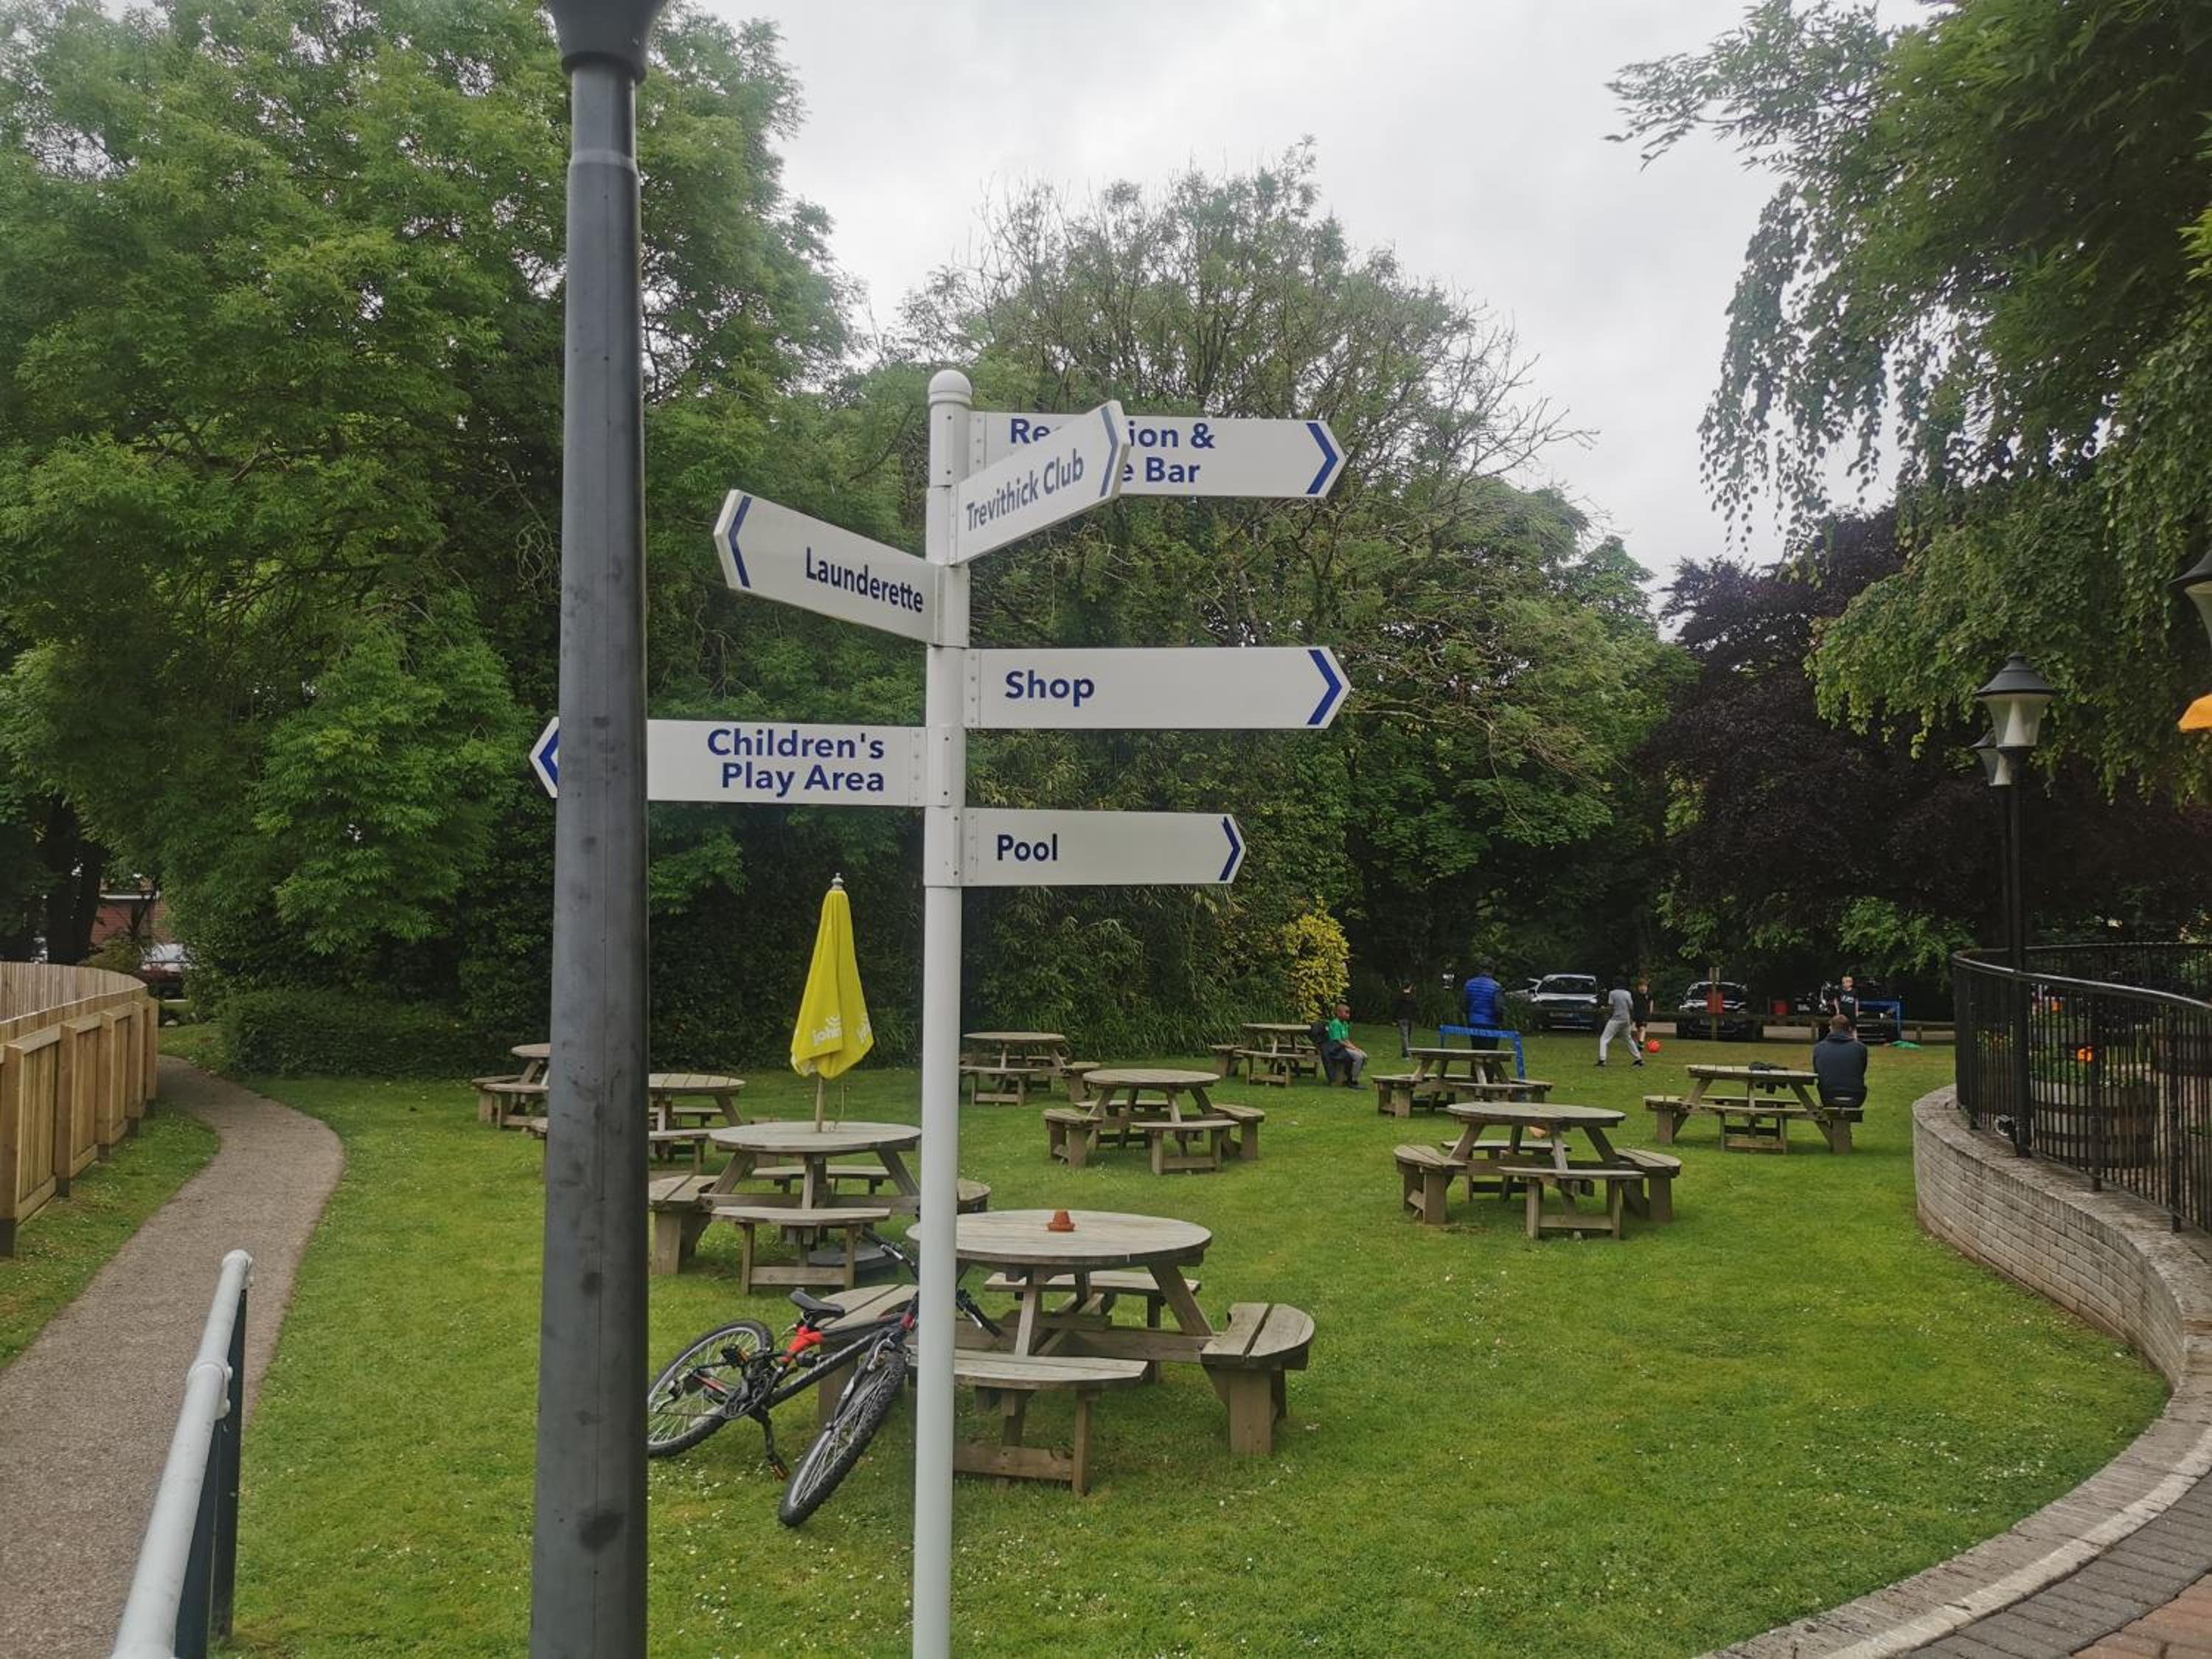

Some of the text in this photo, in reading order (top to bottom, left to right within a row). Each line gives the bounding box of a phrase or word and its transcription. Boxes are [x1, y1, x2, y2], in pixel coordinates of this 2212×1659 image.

[1190, 422, 1216, 449] &
[1146, 456, 1201, 483] Bar
[966, 448, 1084, 532] Trevithick Club
[805, 546, 924, 613] Launderette
[1004, 669, 1095, 707] Shop
[708, 728, 884, 759] Children's
[722, 762, 884, 798] Play Area
[997, 833, 1058, 862] Pool
